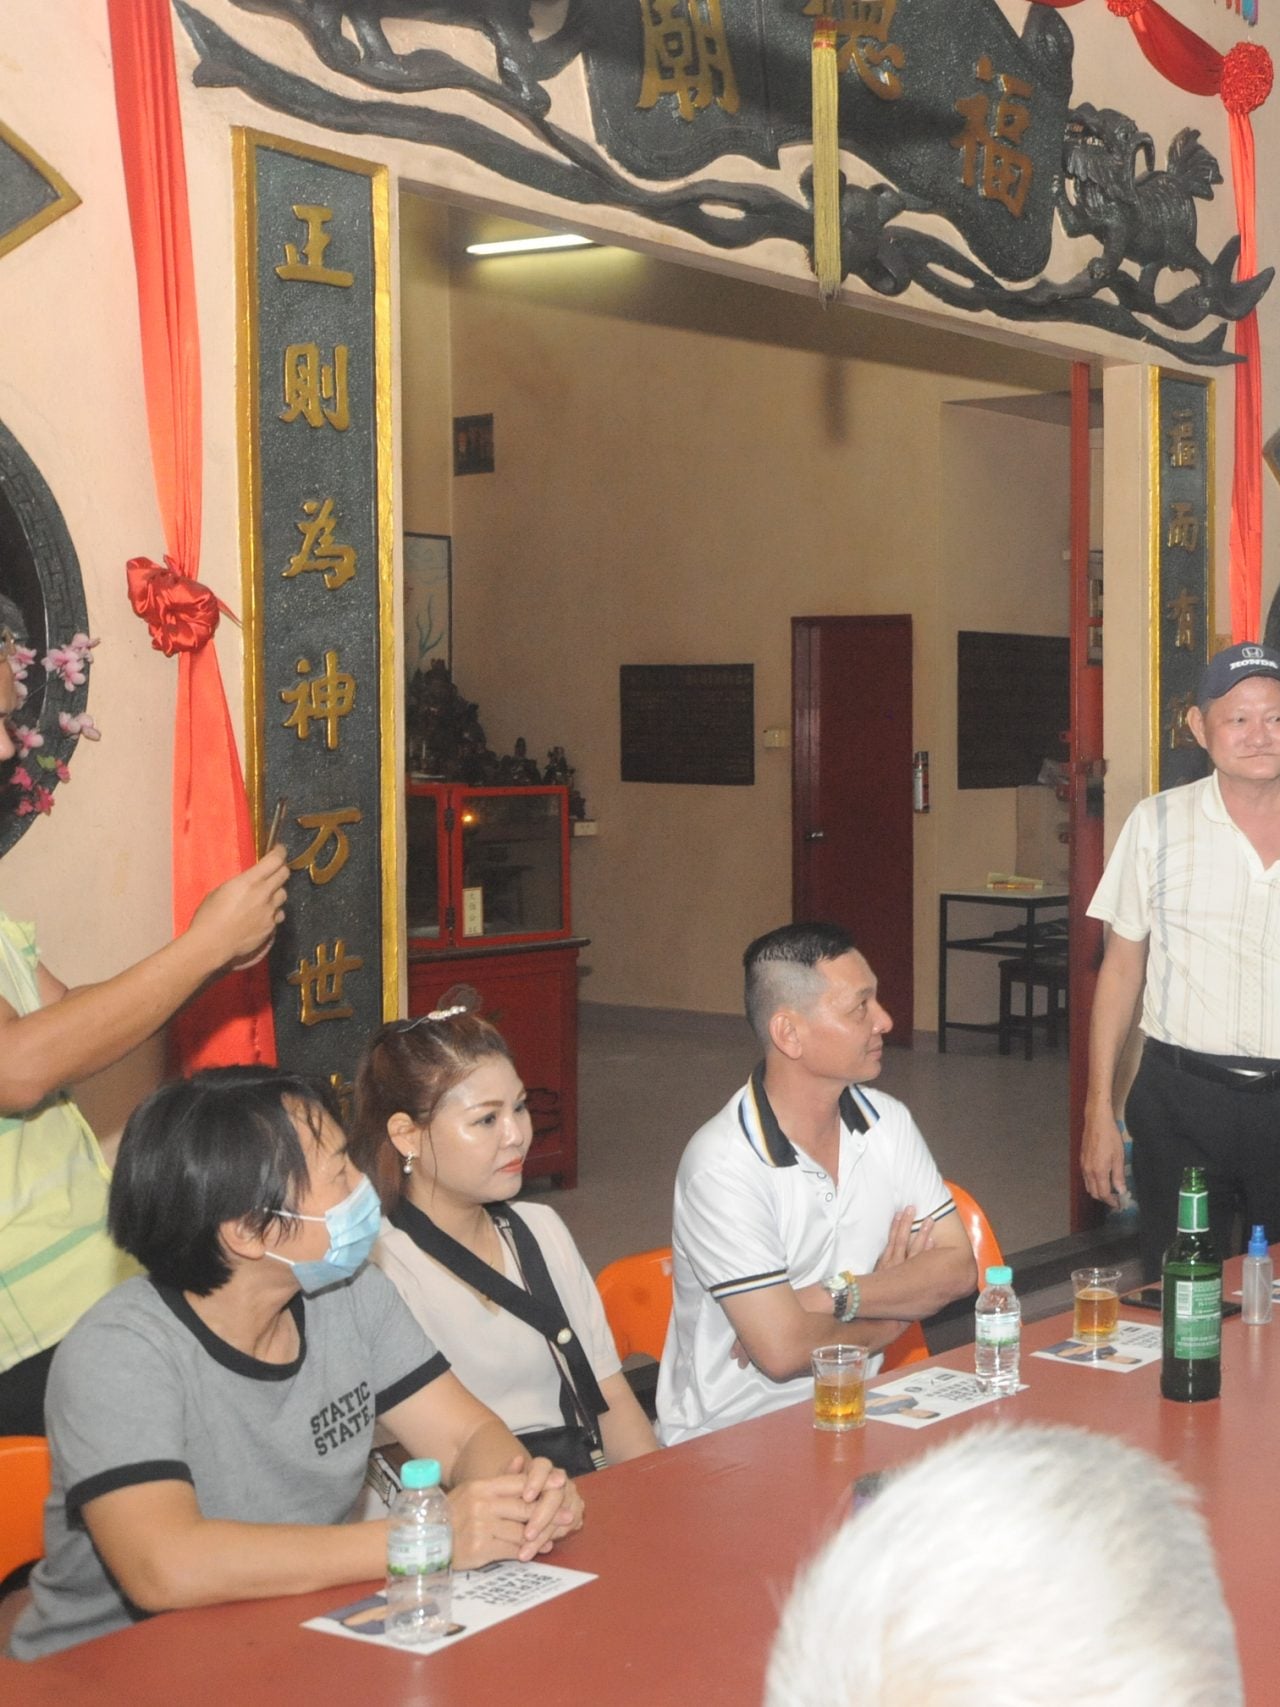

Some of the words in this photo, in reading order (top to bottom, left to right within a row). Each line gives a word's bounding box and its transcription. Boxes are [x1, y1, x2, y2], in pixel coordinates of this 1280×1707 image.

[275, 204, 362, 1116] 正則為神万世
[1229, 659, 1279, 671] HONDA
[310, 1381, 371, 1435] STATIC
